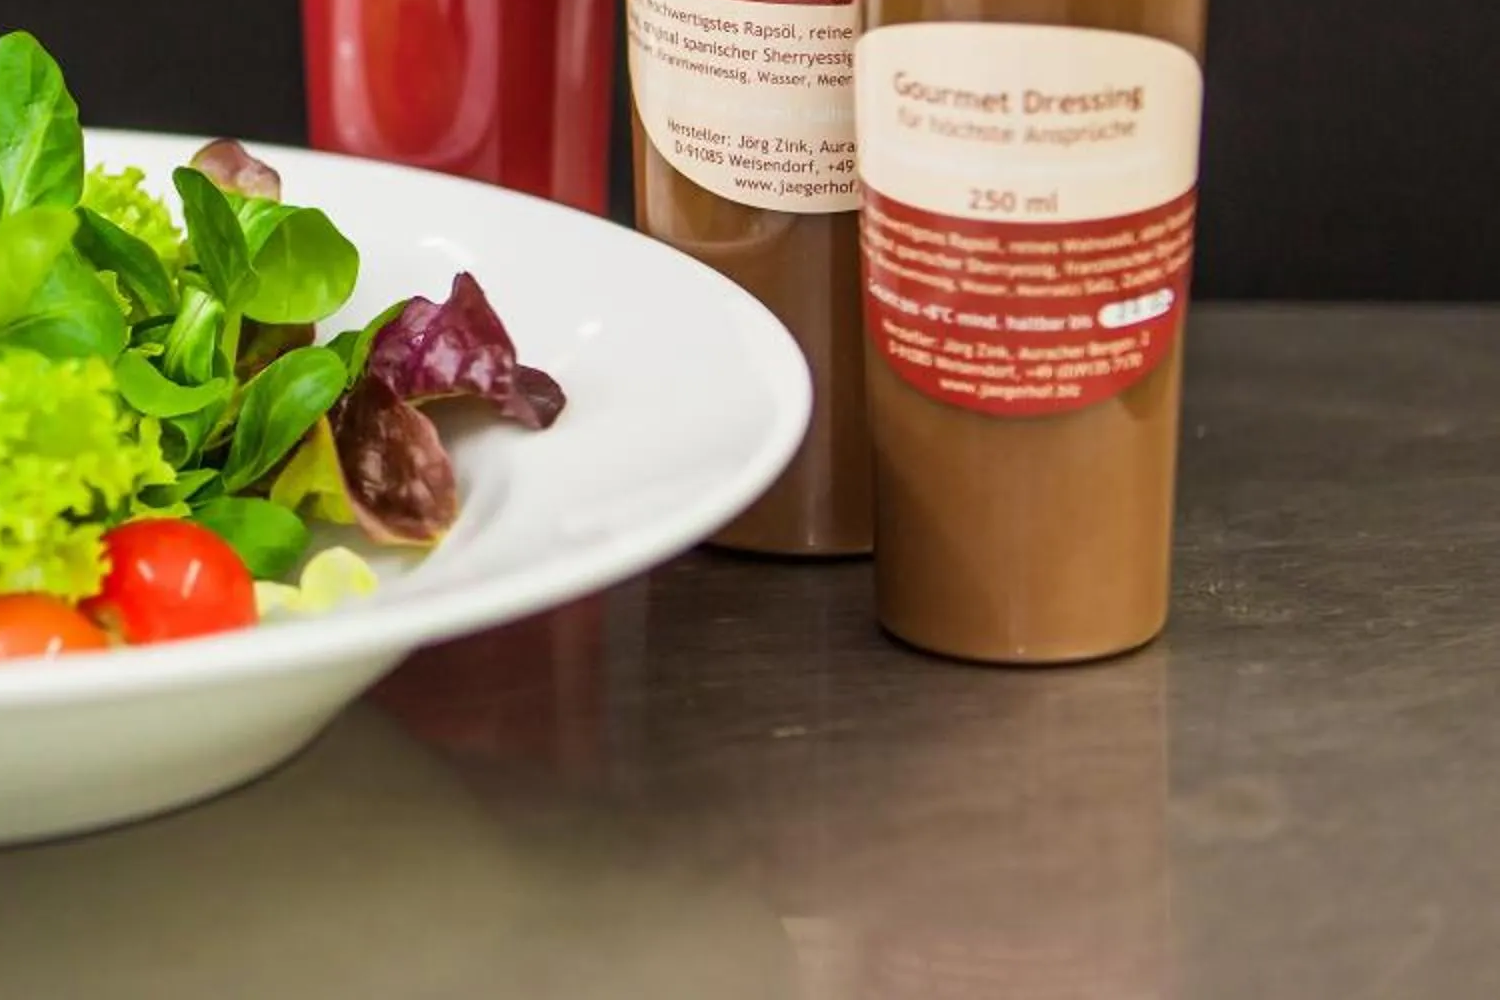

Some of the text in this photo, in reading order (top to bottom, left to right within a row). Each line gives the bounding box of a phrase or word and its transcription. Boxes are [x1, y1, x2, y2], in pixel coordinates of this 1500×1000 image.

[743, 21, 803, 42] Rapsöl,
[683, 36, 758, 62] spanischer
[893, 71, 1012, 112] Gourmet
[1021, 85, 1145, 116] Dressing
[738, 135, 770, 154] Jörg
[828, 160, 855, 173] +49
[969, 188, 1059, 213] 250 ml
